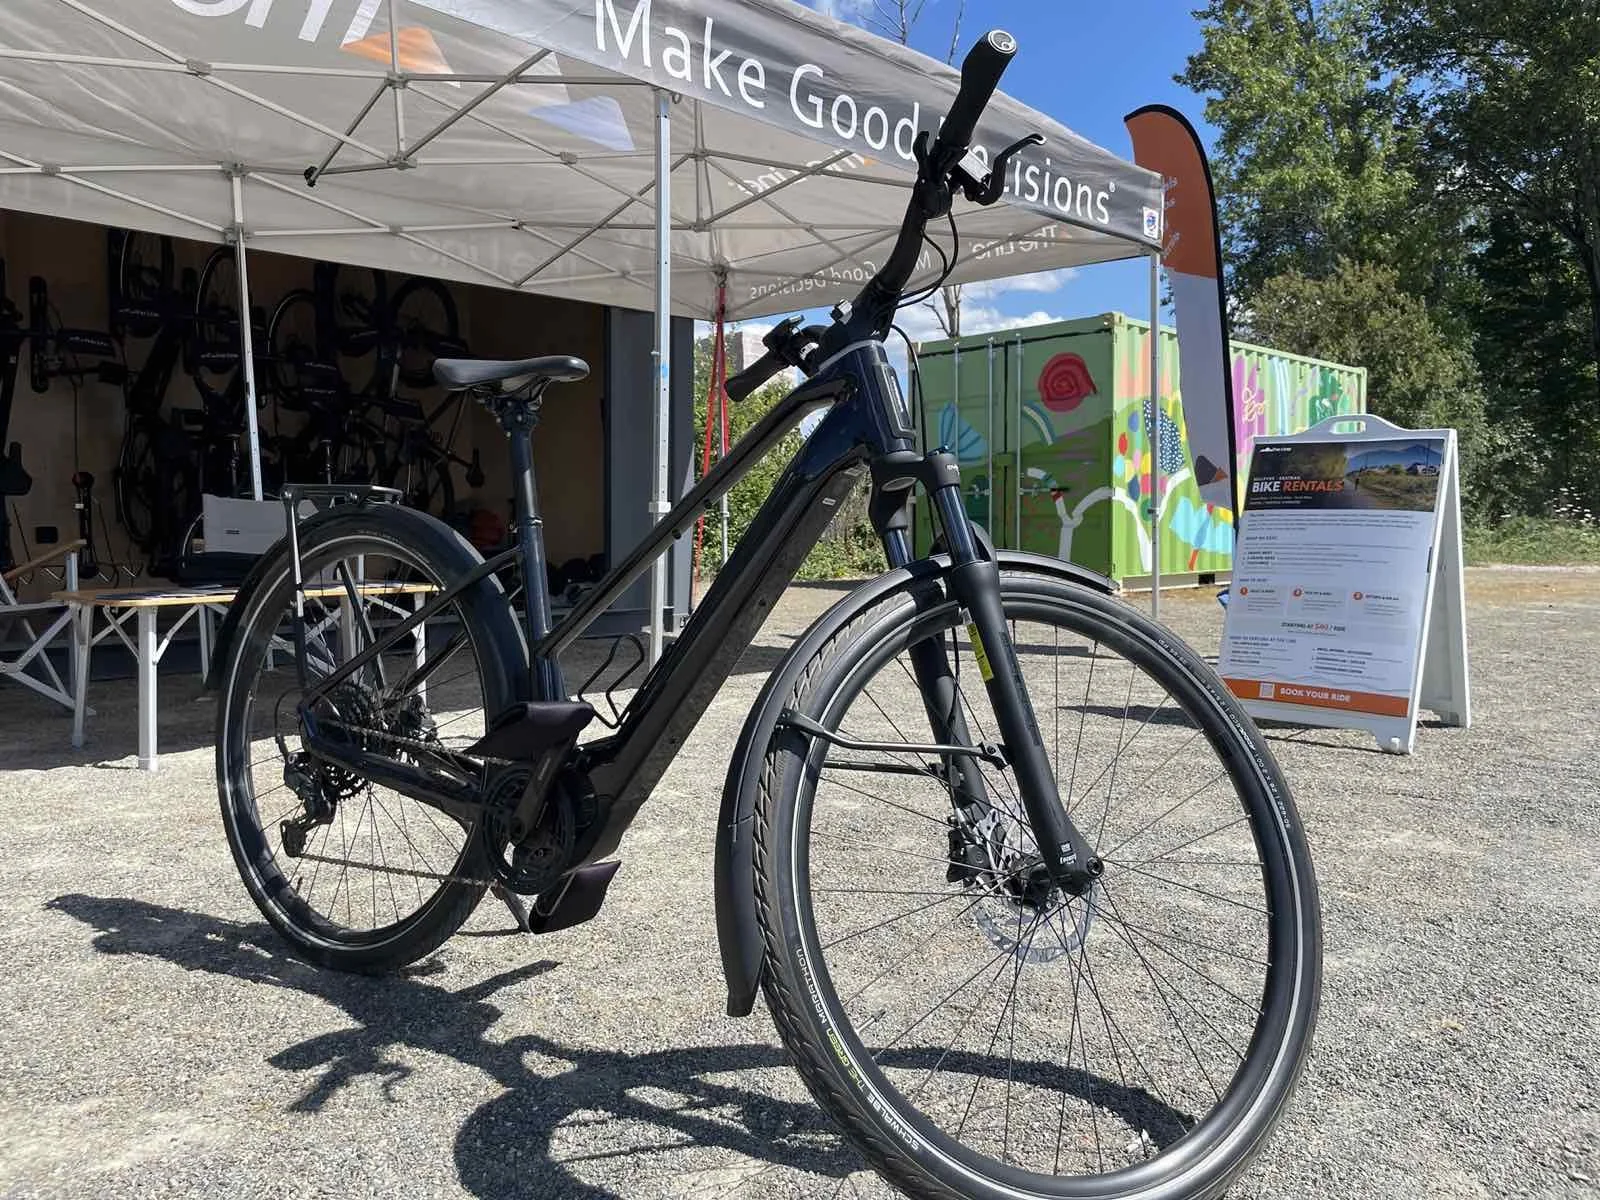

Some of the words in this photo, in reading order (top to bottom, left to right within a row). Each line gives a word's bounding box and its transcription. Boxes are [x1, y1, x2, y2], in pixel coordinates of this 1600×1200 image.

[594, 0, 767, 109] Make
[790, 63, 920, 162] Good
[1252, 481, 1281, 493] BIKE
[1283, 480, 1344, 493] RENTALS
[1280, 687, 1304, 696] BOOK
[1305, 690, 1329, 699] YOUR
[1331, 693, 1351, 702] RIDE
[796, 947, 828, 1024] MARATHON
[848, 1068, 866, 1093] THE
[867, 1094, 920, 1151] SCHWALBE
